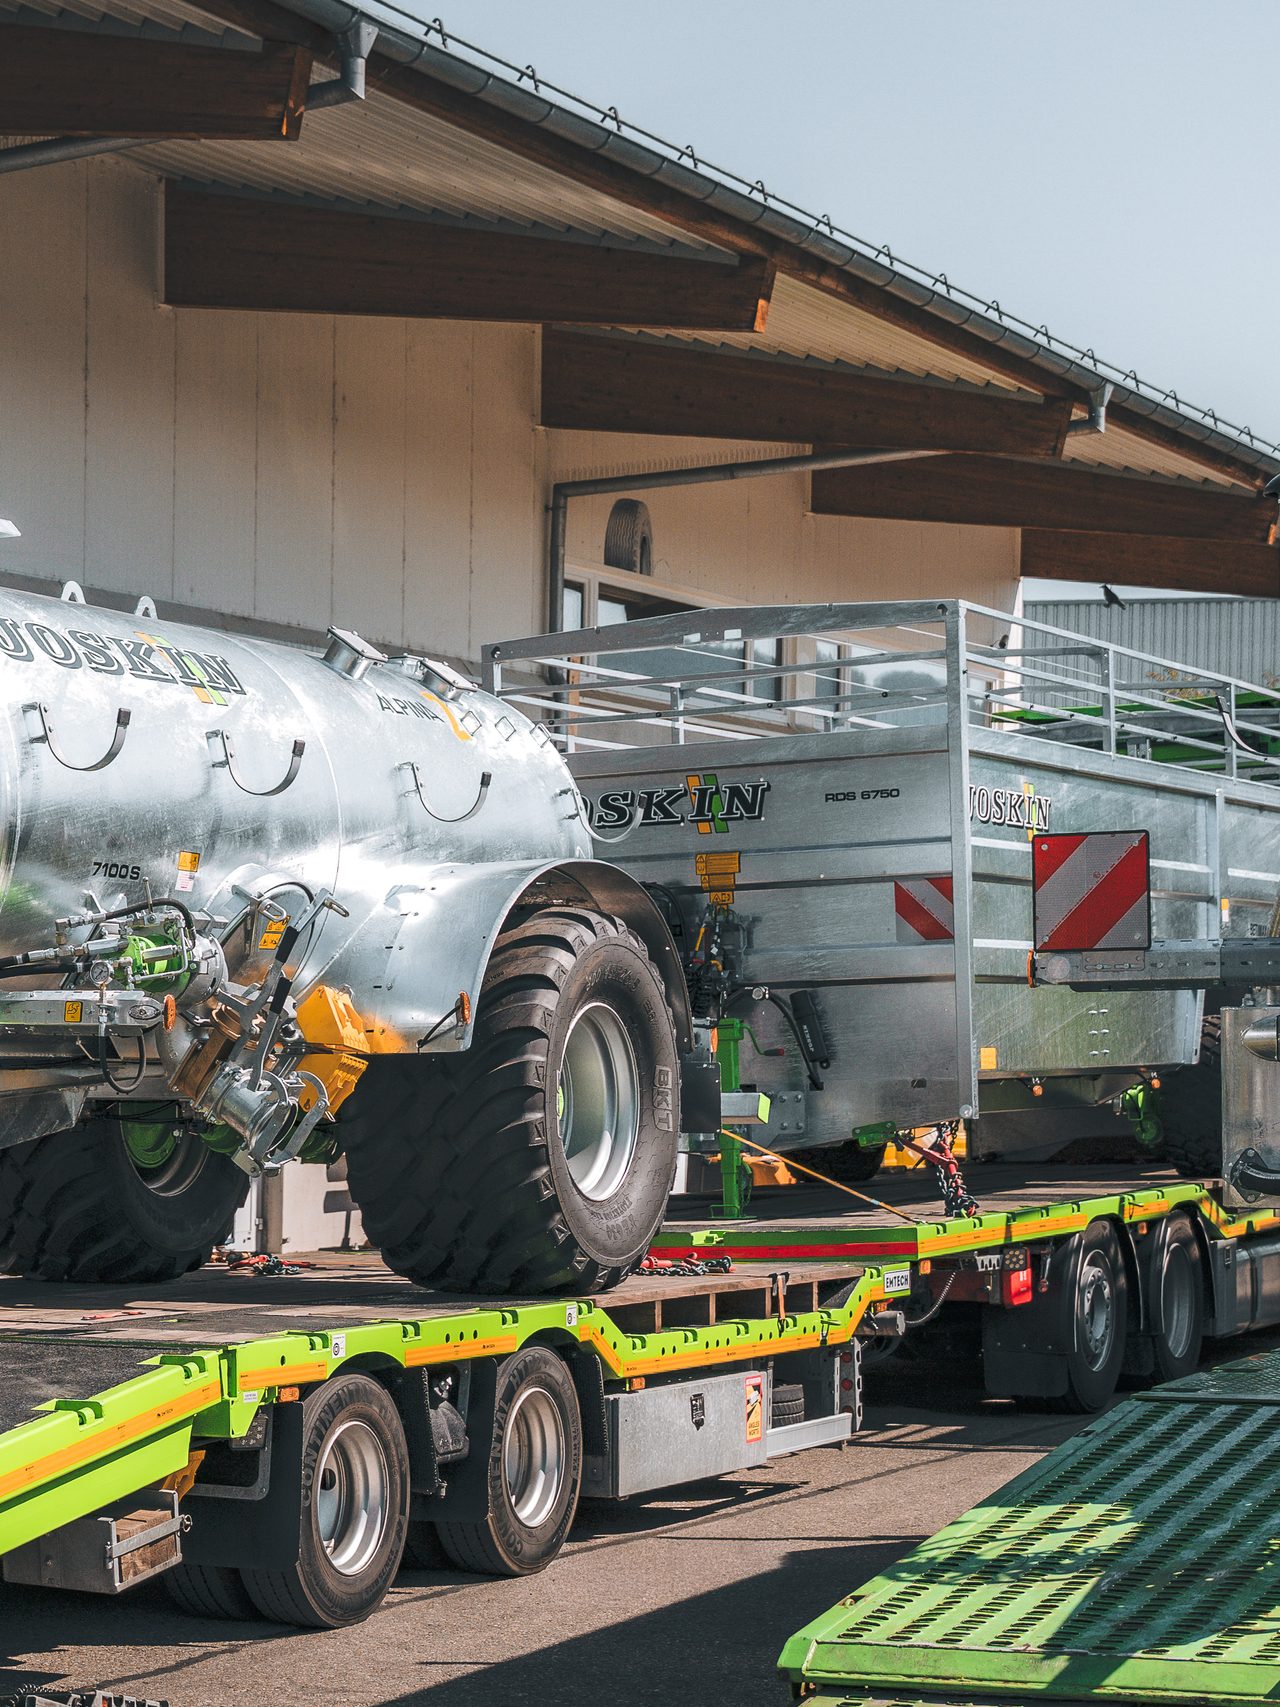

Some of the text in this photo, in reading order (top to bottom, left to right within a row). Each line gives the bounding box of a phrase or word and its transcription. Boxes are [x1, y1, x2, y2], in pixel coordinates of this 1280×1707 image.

[375, 692, 446, 723] ALPINA
[582, 780, 772, 830] SKIN
[824, 788, 900, 803] RDS 6750
[968, 783, 1052, 832] JOSKIN
[652, 1064, 674, 1132] BKT
[885, 1274, 909, 1289] EMTECH
